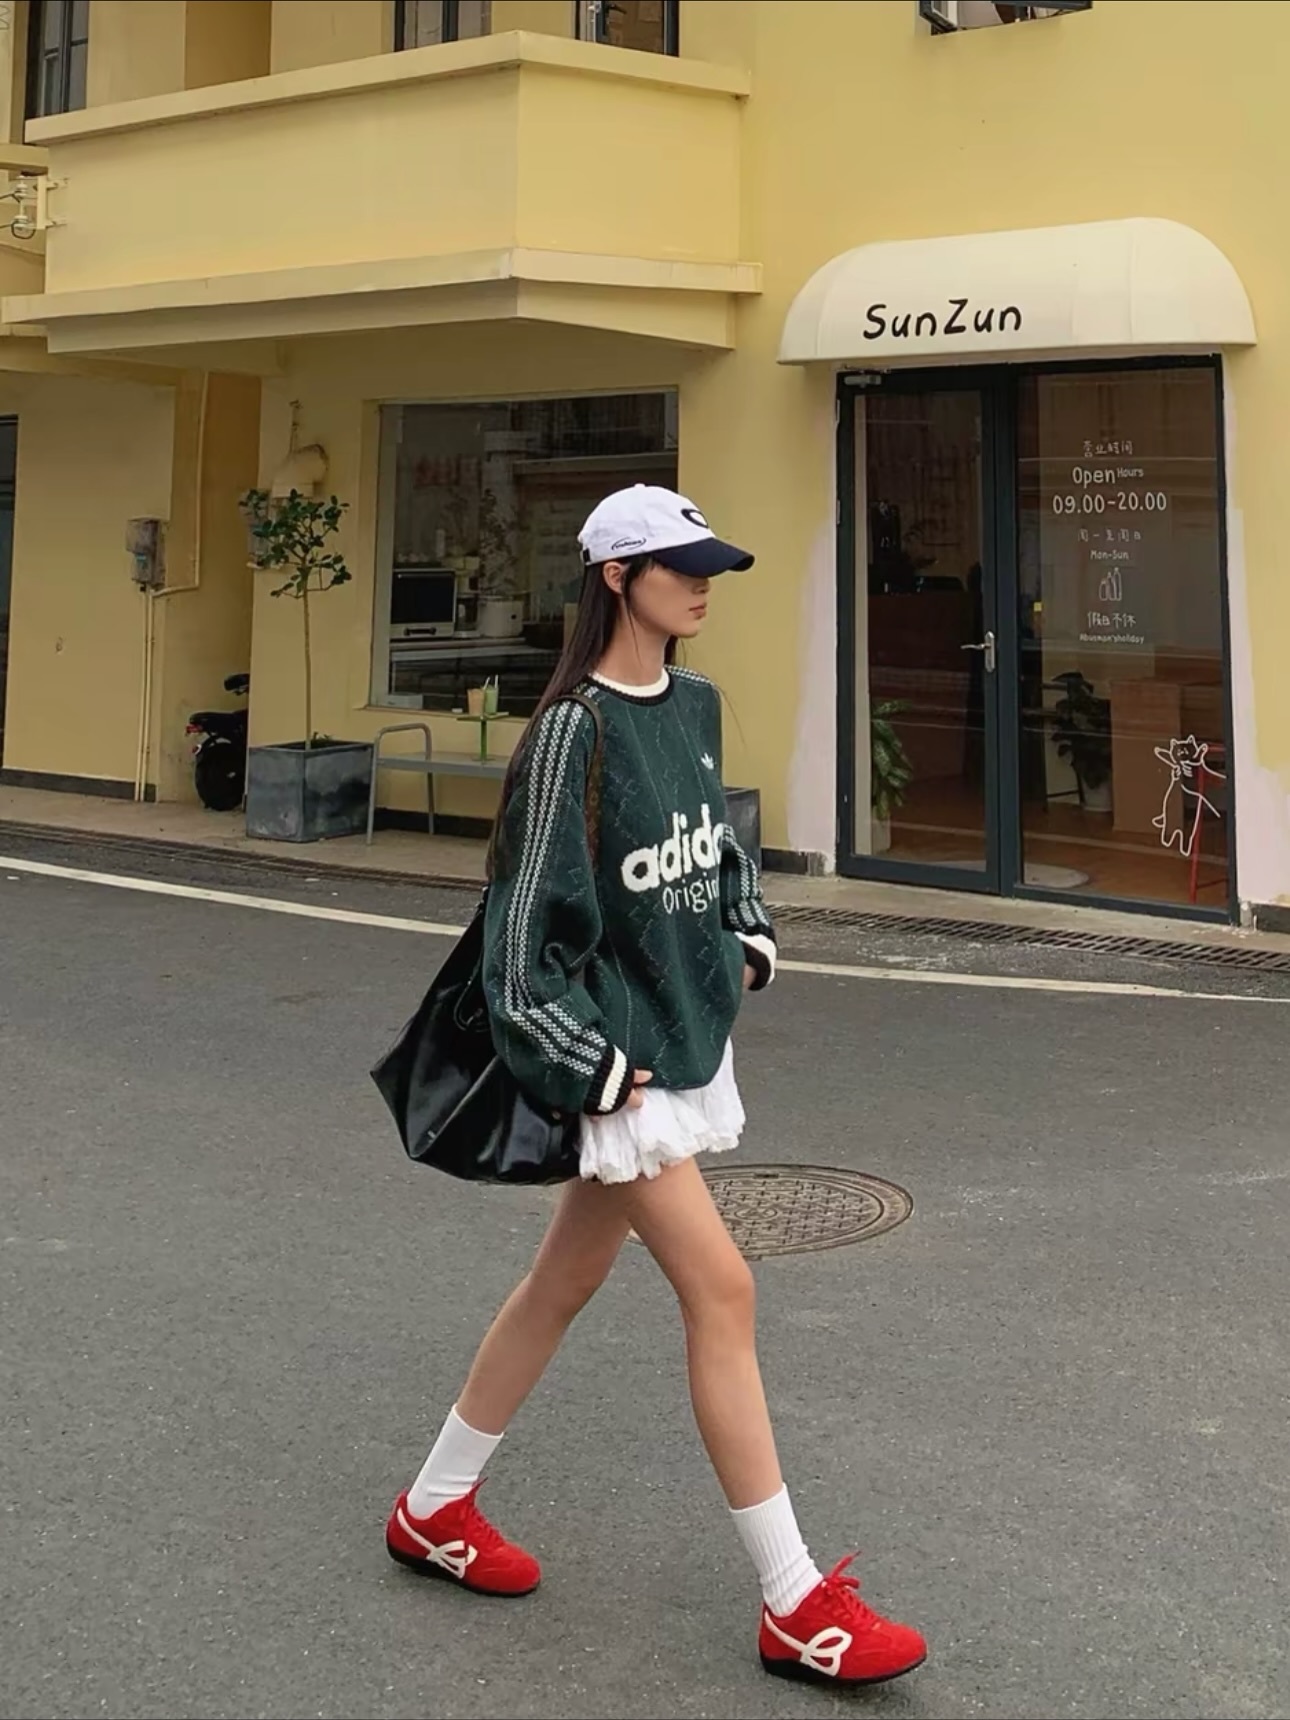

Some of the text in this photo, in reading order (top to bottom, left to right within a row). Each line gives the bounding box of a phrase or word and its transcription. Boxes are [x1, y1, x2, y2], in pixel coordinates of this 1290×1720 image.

[1072, 466, 1144, 489] Open Hours
[1052, 491, 1167, 514] 09.00-20.00
[1090, 549, 1129, 560] Mon-Sun
[1087, 611, 1136, 628] 假日不休
